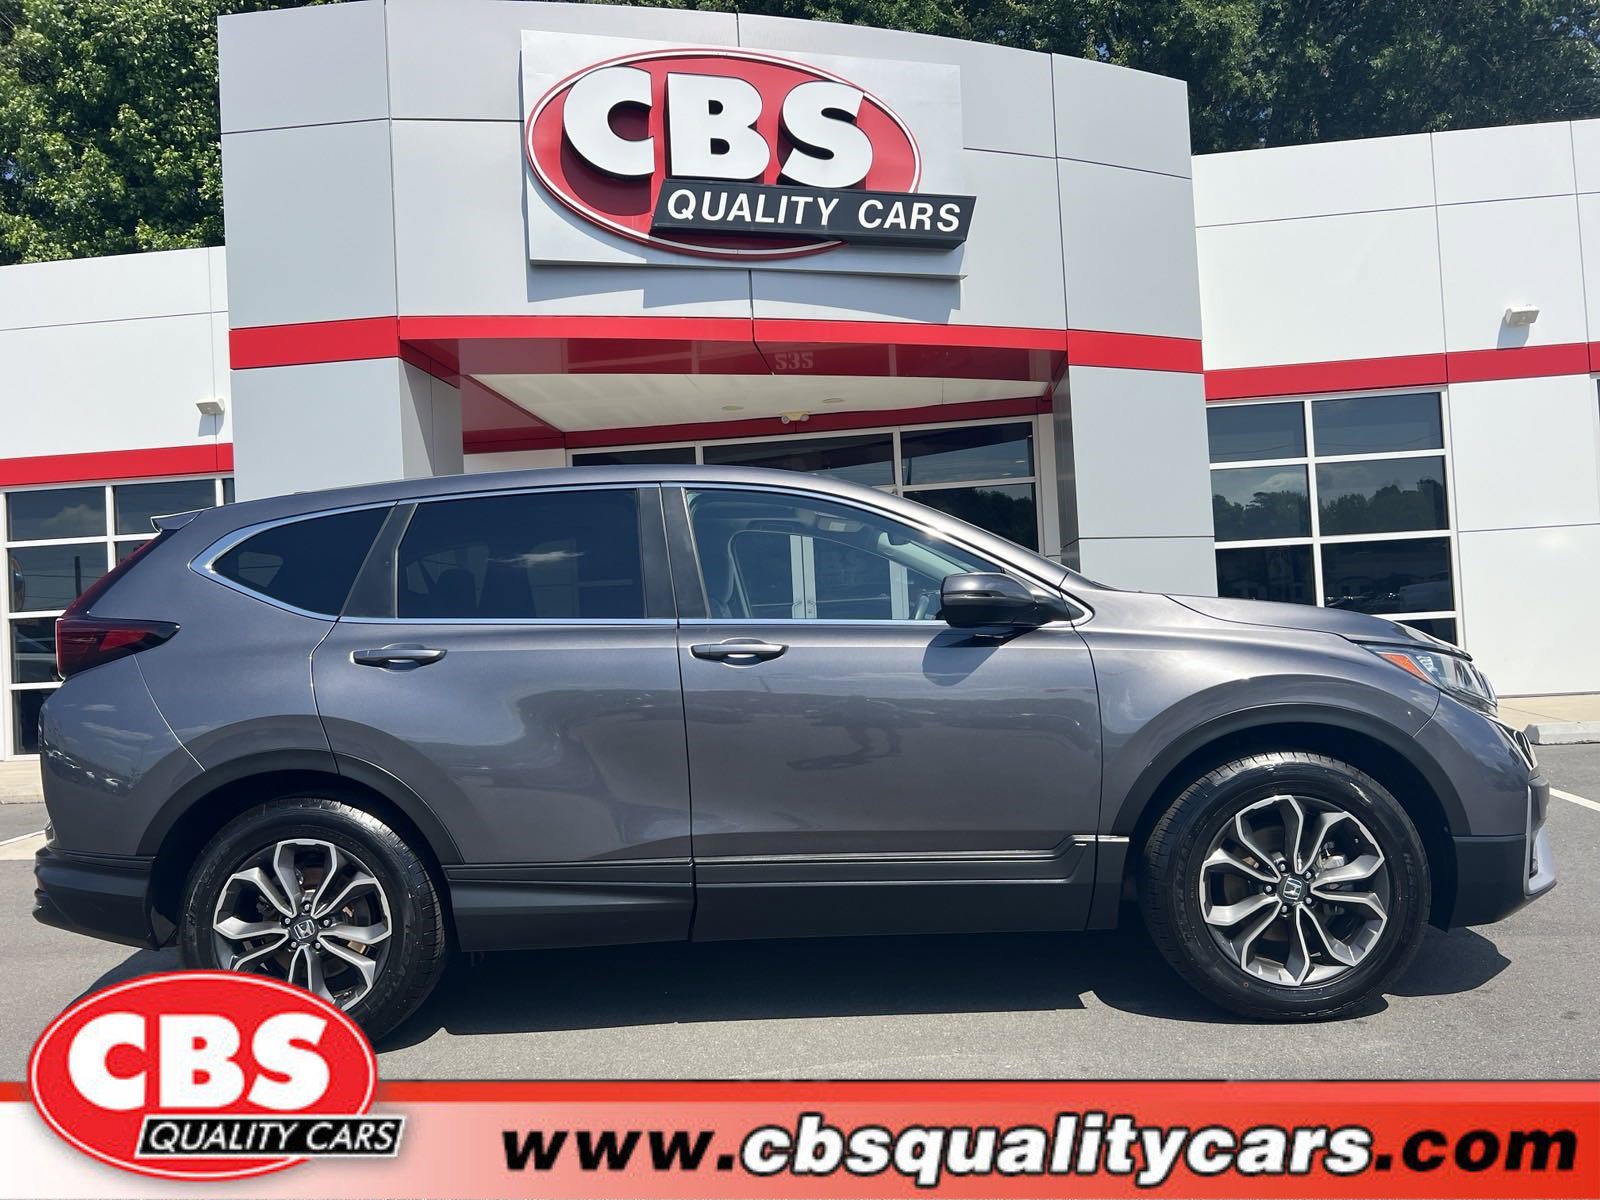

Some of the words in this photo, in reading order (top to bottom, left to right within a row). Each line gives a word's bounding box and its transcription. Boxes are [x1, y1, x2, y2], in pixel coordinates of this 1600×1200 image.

[563, 66, 873, 188] CBS
[667, 189, 840, 227] QUALITY
[858, 200, 961, 233] CARS
